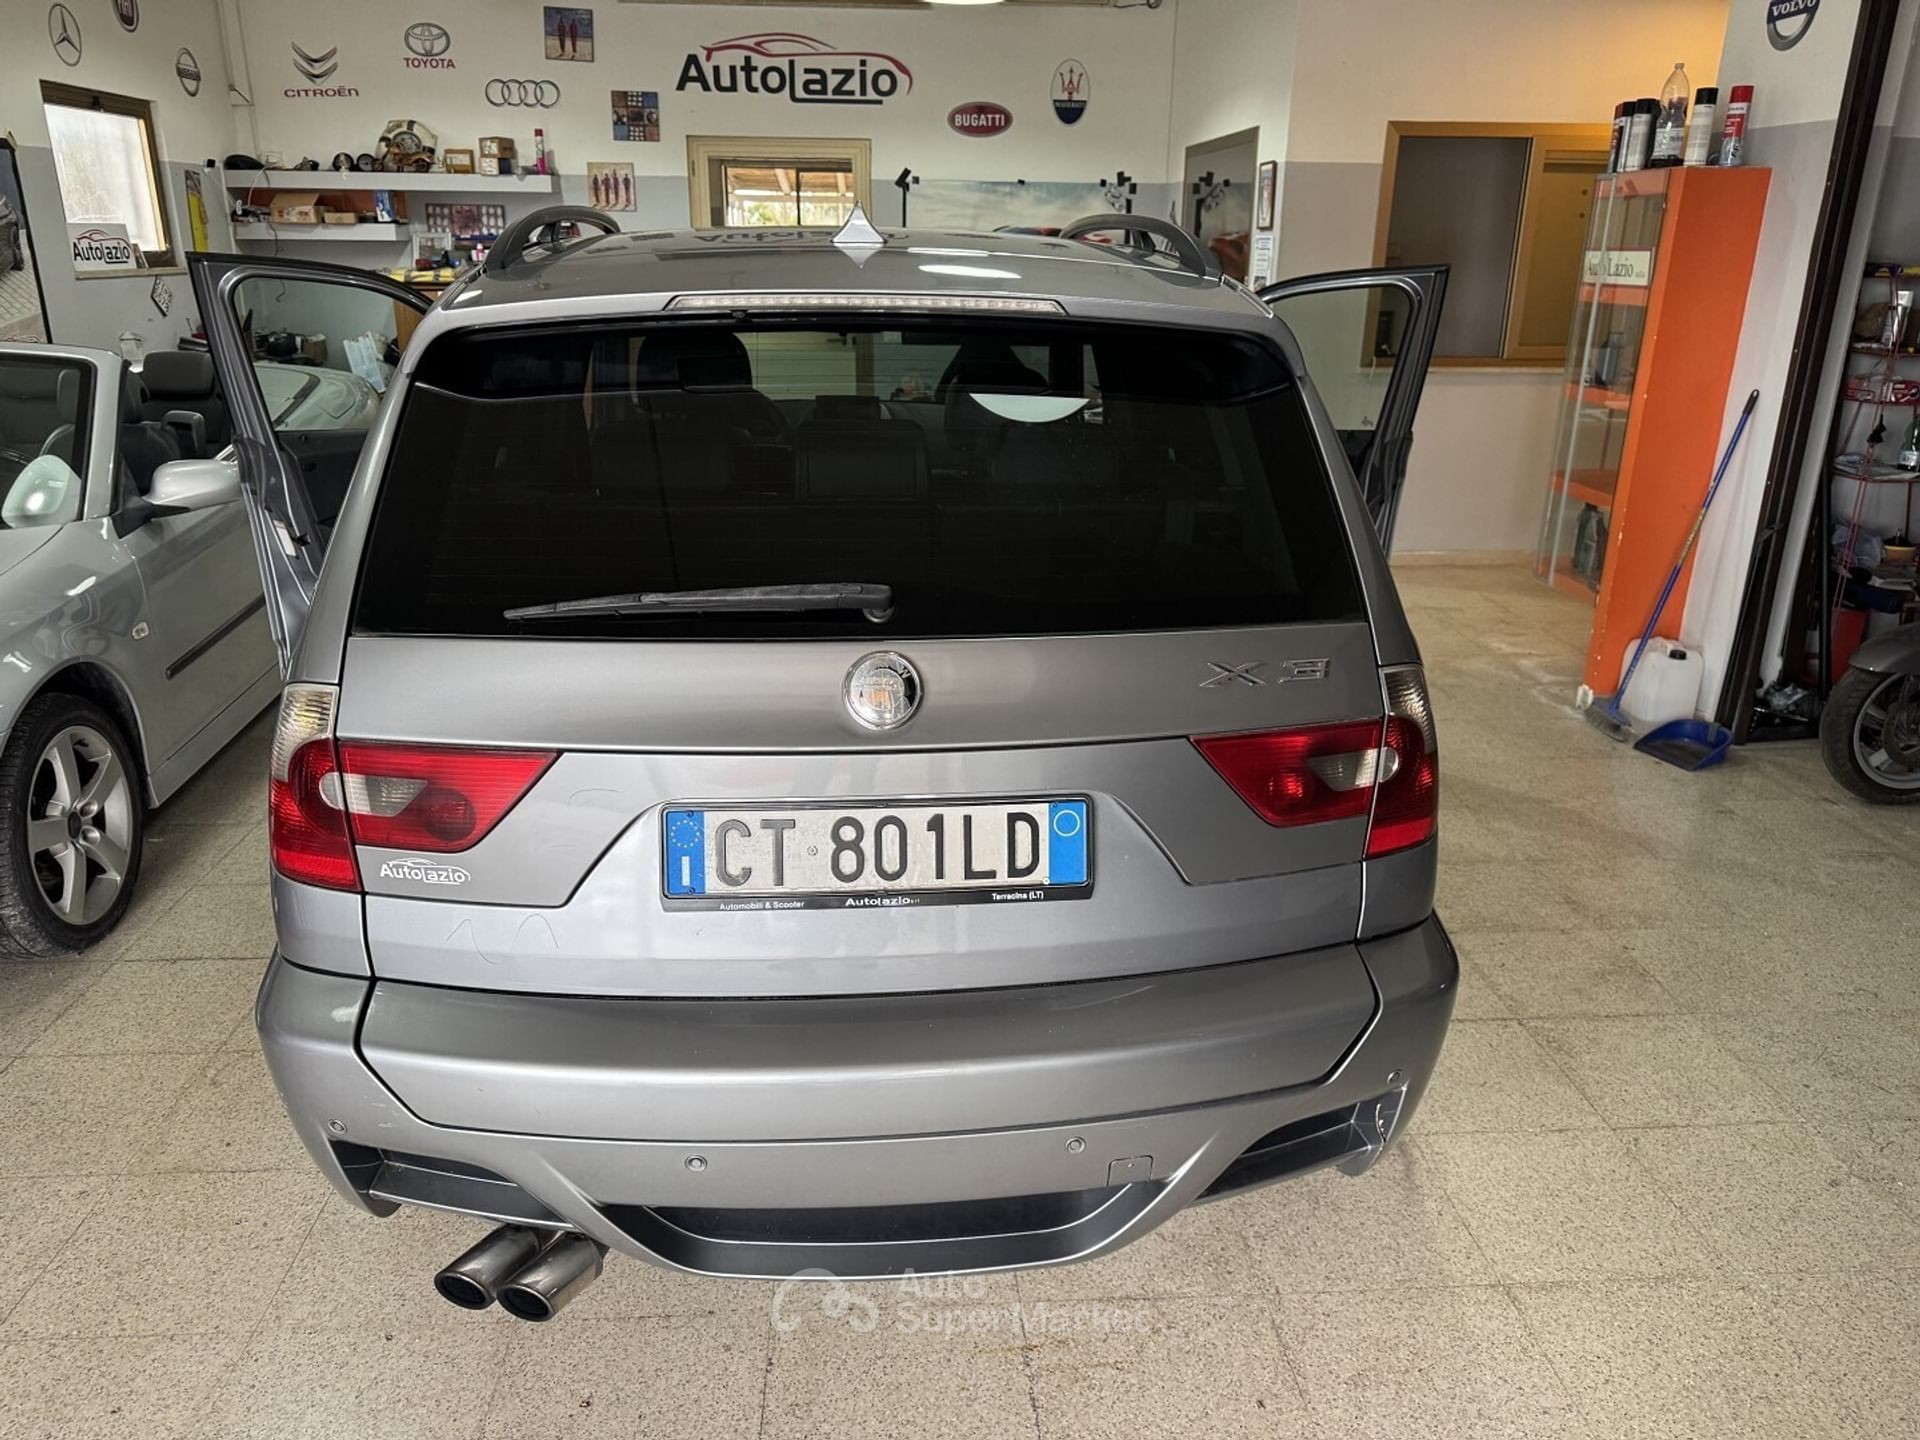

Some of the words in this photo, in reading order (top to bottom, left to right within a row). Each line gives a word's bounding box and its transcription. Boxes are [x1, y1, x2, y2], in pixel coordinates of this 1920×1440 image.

[1772, 0, 1817, 16] VOLVO
[403, 57, 456, 69] TOYOTA
[954, 114, 1005, 127] BUGATTI
[1199, 658, 1330, 688] X3
[715, 818, 796, 887] CT
[831, 812, 1040, 884] 801LD
[992, 892, 1028, 901] Terracina
[1029, 890, 1044, 900] (LT)
[773, 901, 805, 909] Scooter
